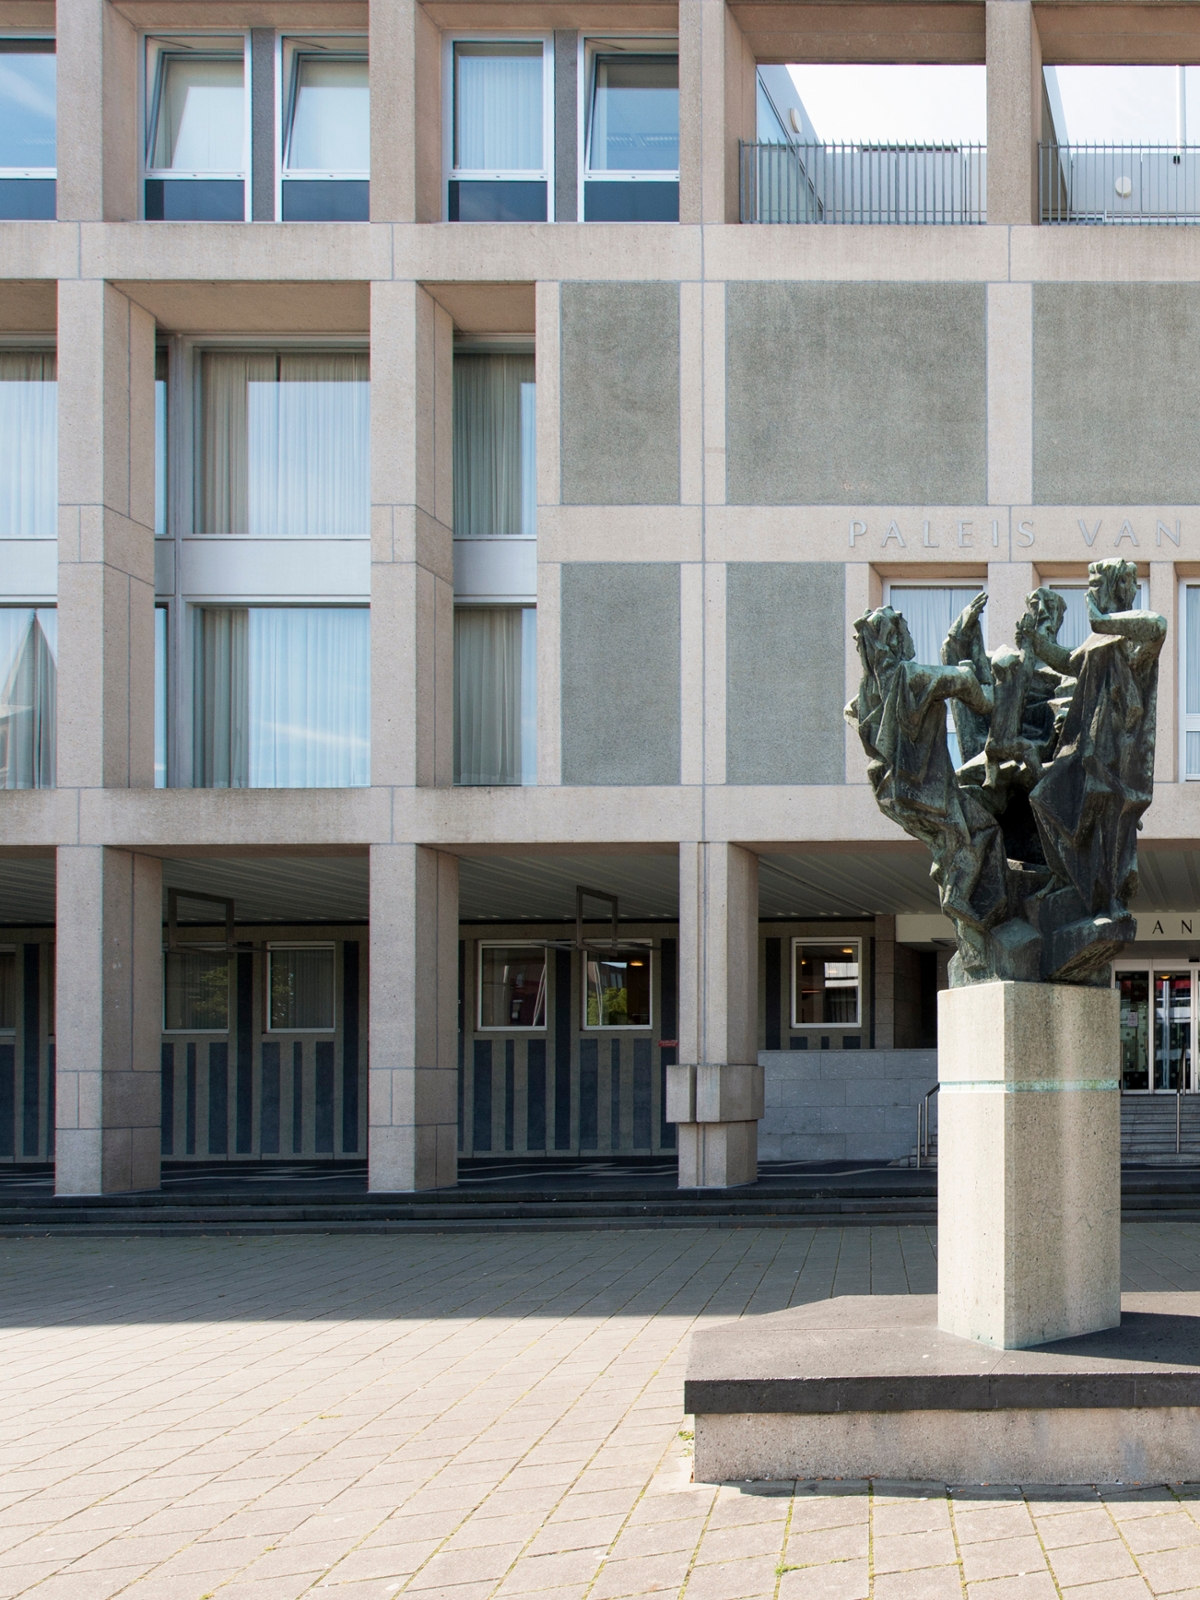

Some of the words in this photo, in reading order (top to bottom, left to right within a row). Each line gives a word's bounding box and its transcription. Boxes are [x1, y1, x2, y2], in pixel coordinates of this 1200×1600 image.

[848, 519, 1036, 549] PALEIS
[1077, 518, 1182, 548] VAN
[1151, 919, 1193, 935] AN
